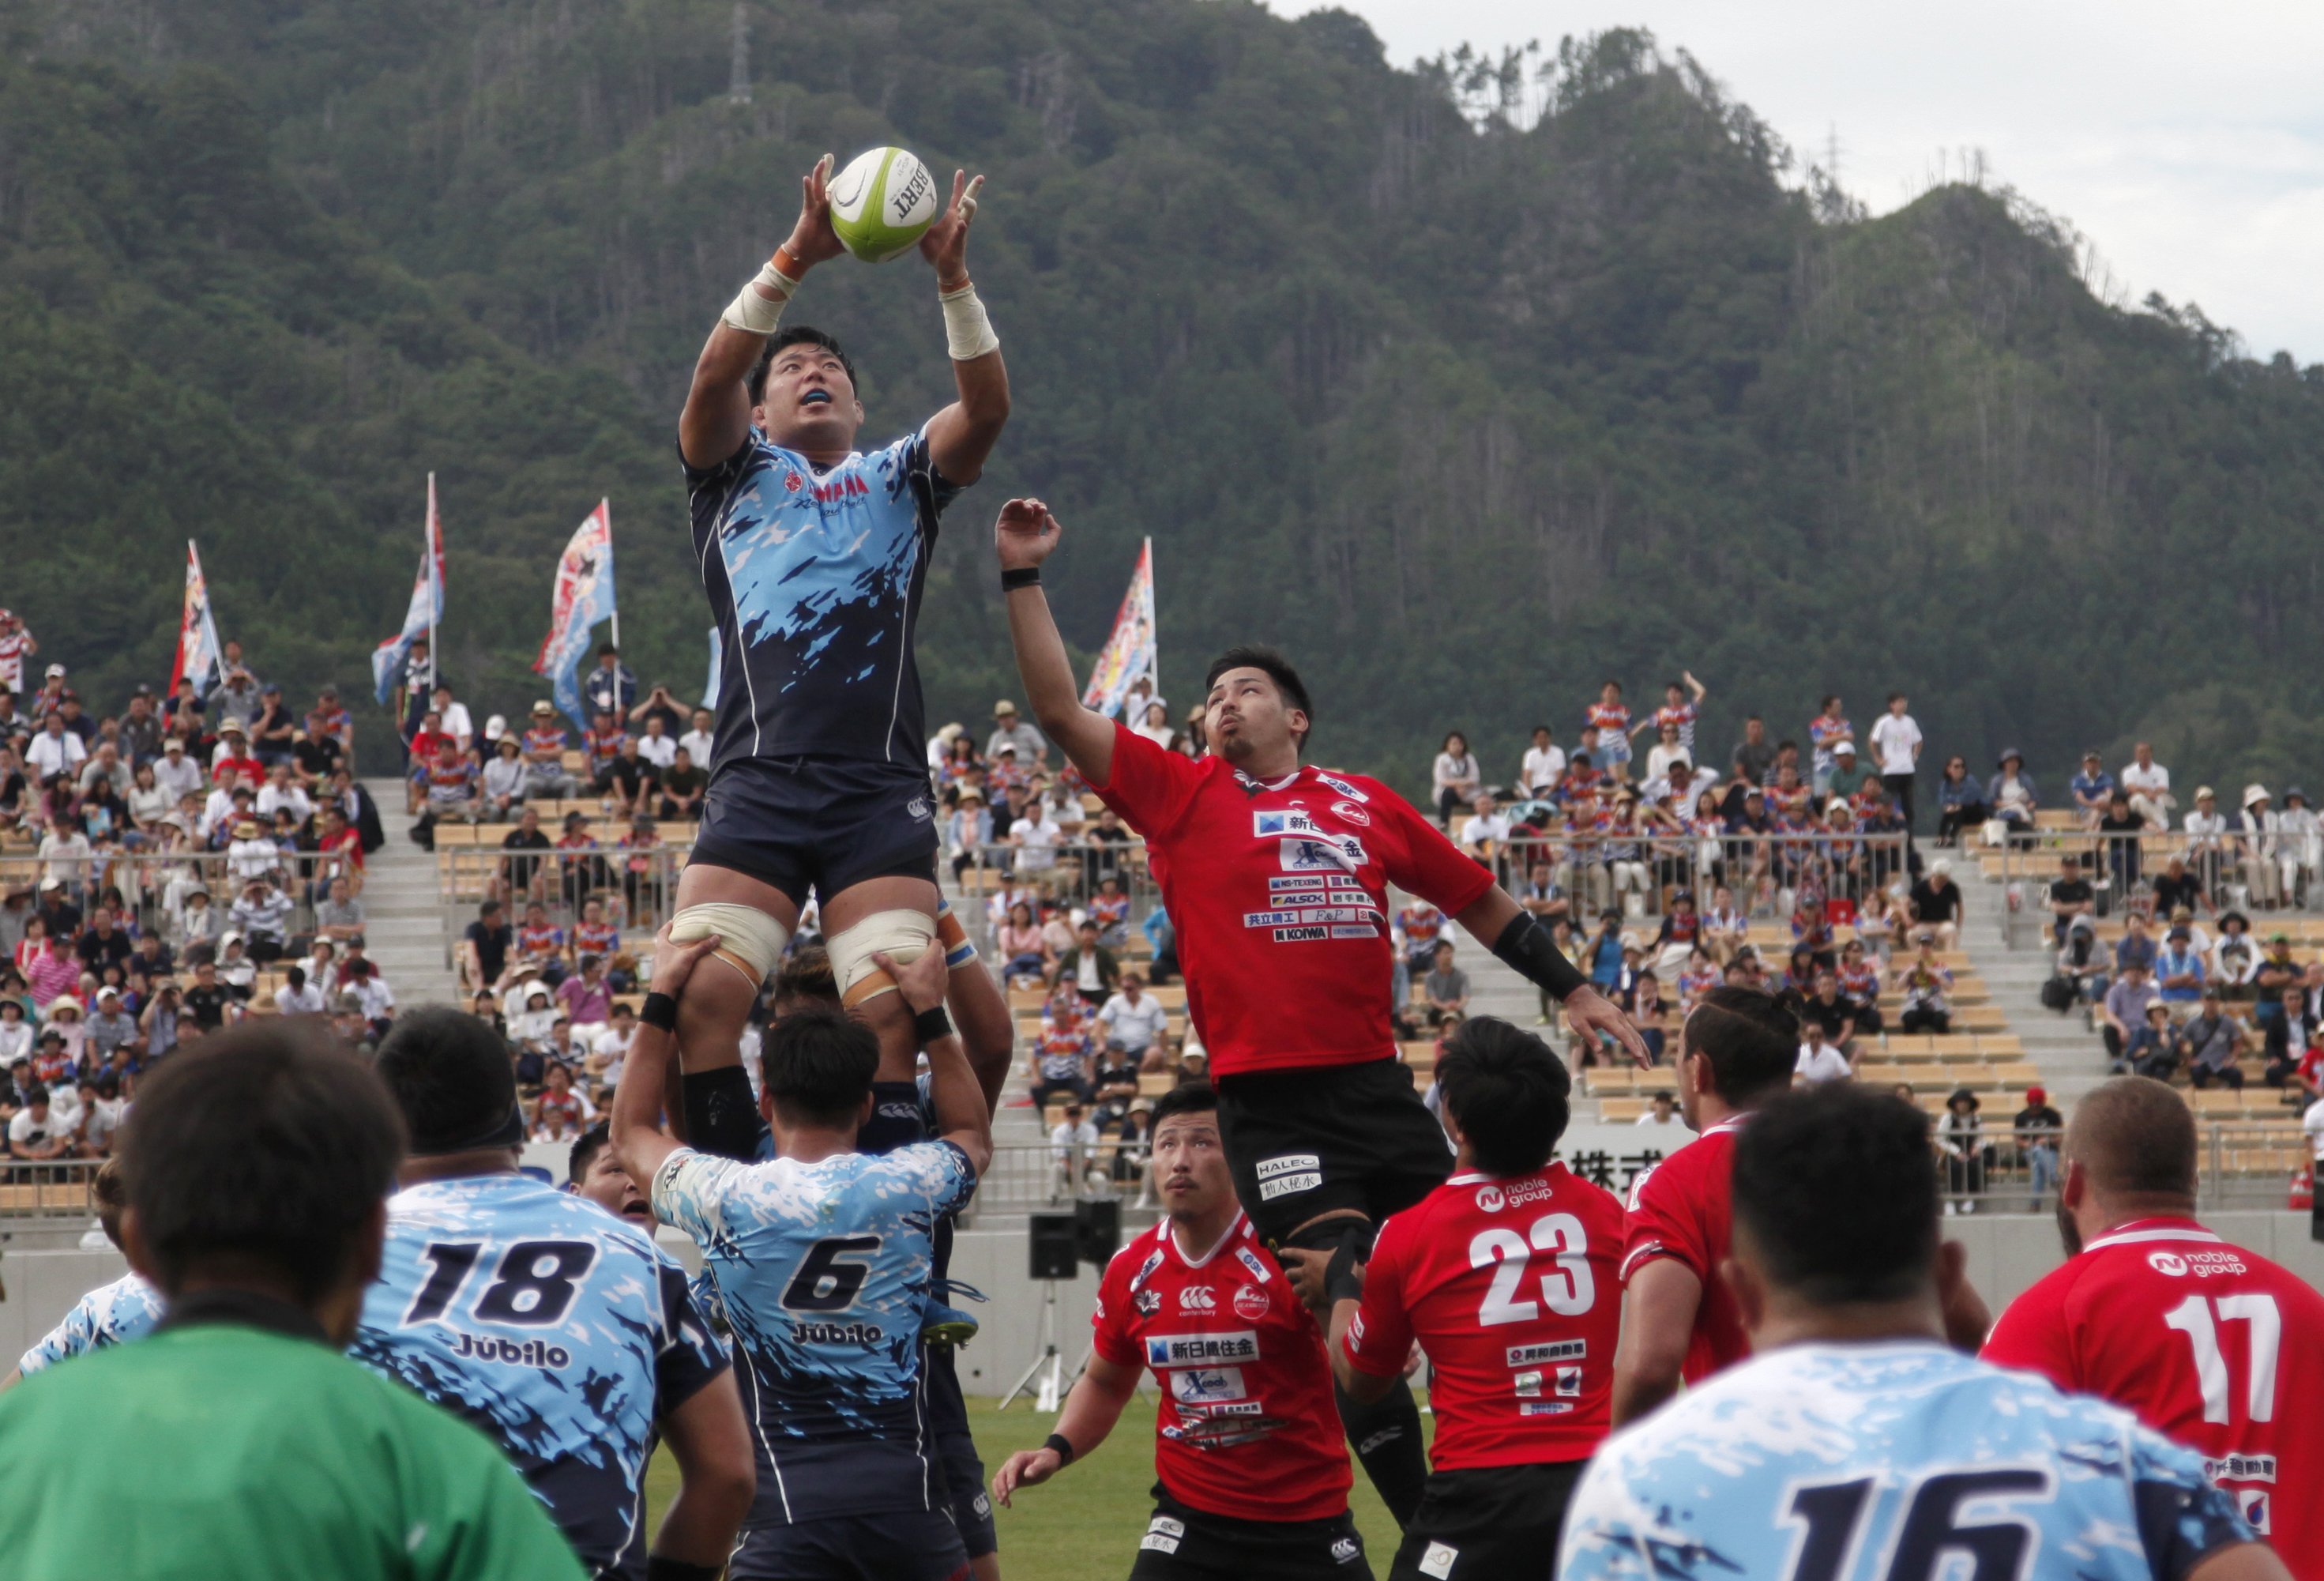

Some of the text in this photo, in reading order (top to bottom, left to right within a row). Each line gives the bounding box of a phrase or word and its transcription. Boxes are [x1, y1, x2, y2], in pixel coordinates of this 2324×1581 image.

[1283, 894, 1324, 905] ALSOK
[1248, 913, 1295, 926] 共立精工
[1314, 909, 1343, 921] F&P
[1287, 927, 1326, 940] KOIWA
[1259, 1158, 1315, 1176] HALEO
[1506, 1179, 1548, 1195] noble
[1509, 1188, 1553, 1208] group
[2185, 1252, 2239, 1263] noble
[780, 1233, 882, 1312] 6
[1469, 1213, 1596, 1327] 23
[2193, 1263, 2247, 1278] group
[401, 1239, 600, 1327] 18
[2164, 1294, 2281, 1425] 17
[1784, 1468, 2051, 1581] 16
